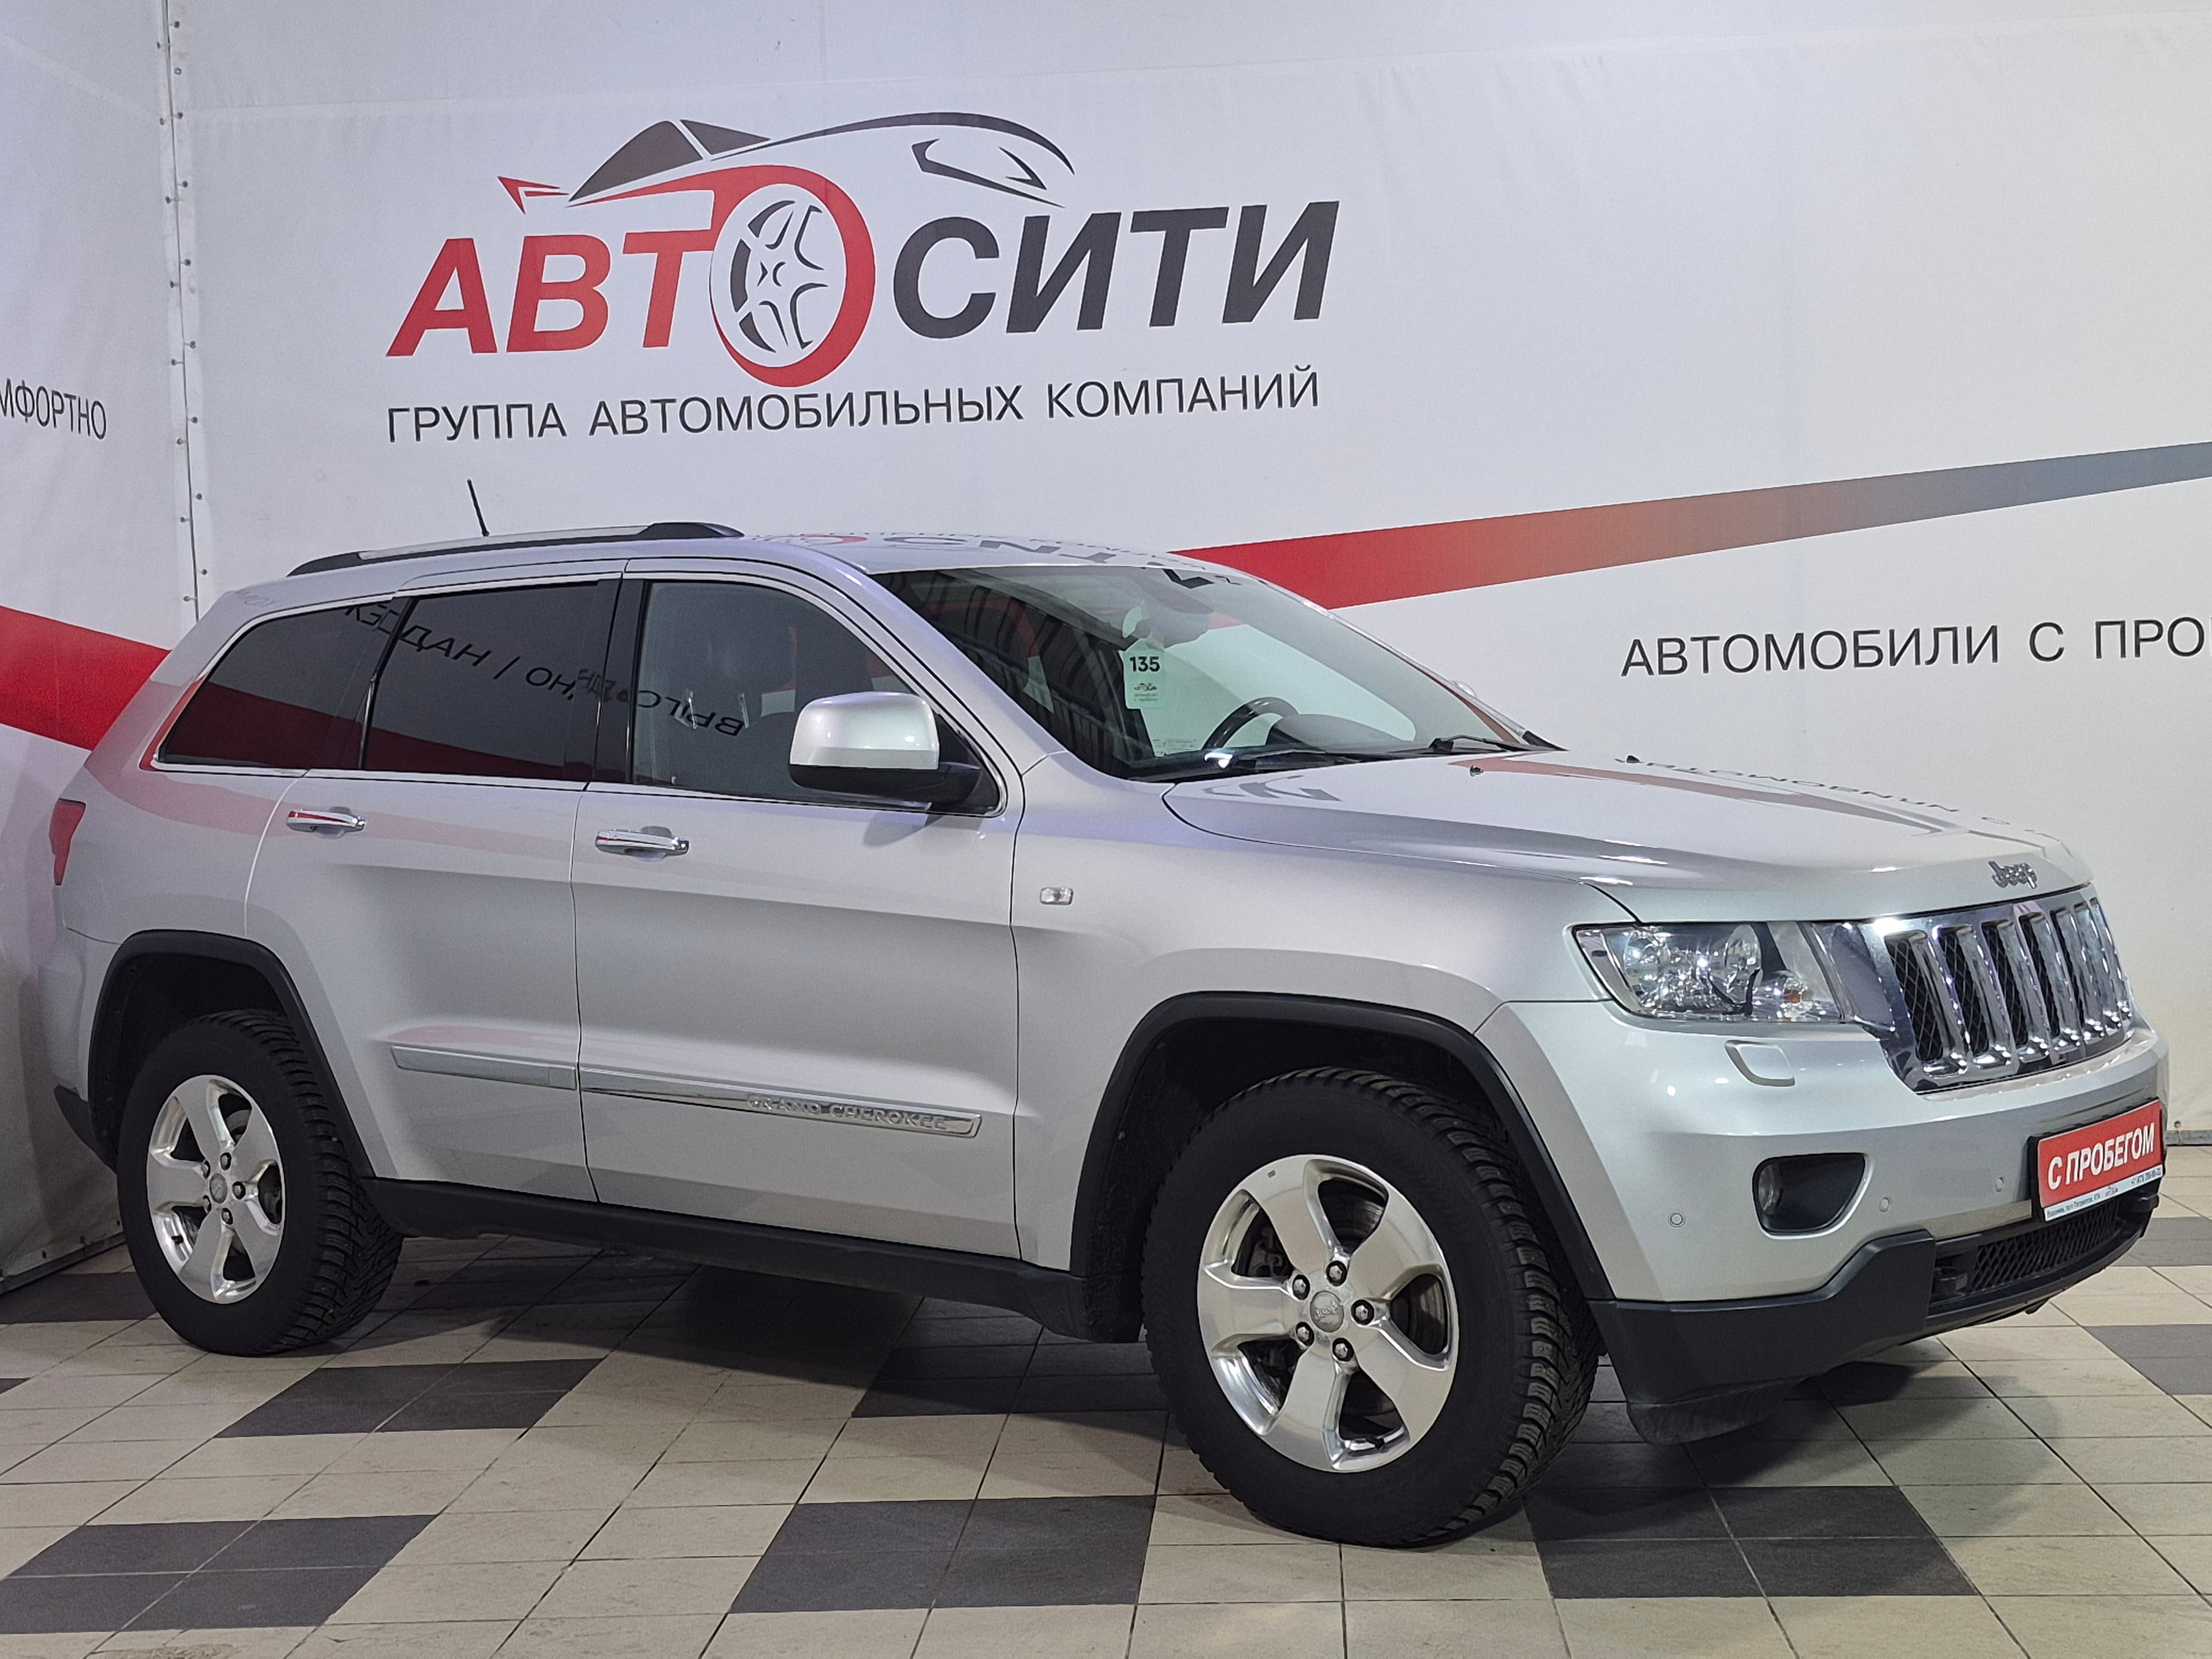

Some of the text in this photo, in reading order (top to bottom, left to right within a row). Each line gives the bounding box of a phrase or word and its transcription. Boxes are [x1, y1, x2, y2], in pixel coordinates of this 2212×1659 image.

[388, 365, 1319, 443] ГРУППА АВТОМОБИЛЬНЫХ КОМПАНИЙ
[1130, 656, 1160, 672] 135
[1620, 624, 1998, 676] АВТОМОБИЛИ
[2029, 622, 2065, 662] С
[748, 1095, 947, 1129] GRAND CHEROKEE
[2047, 1122, 2156, 1190] С ПРОБЕГОМ
